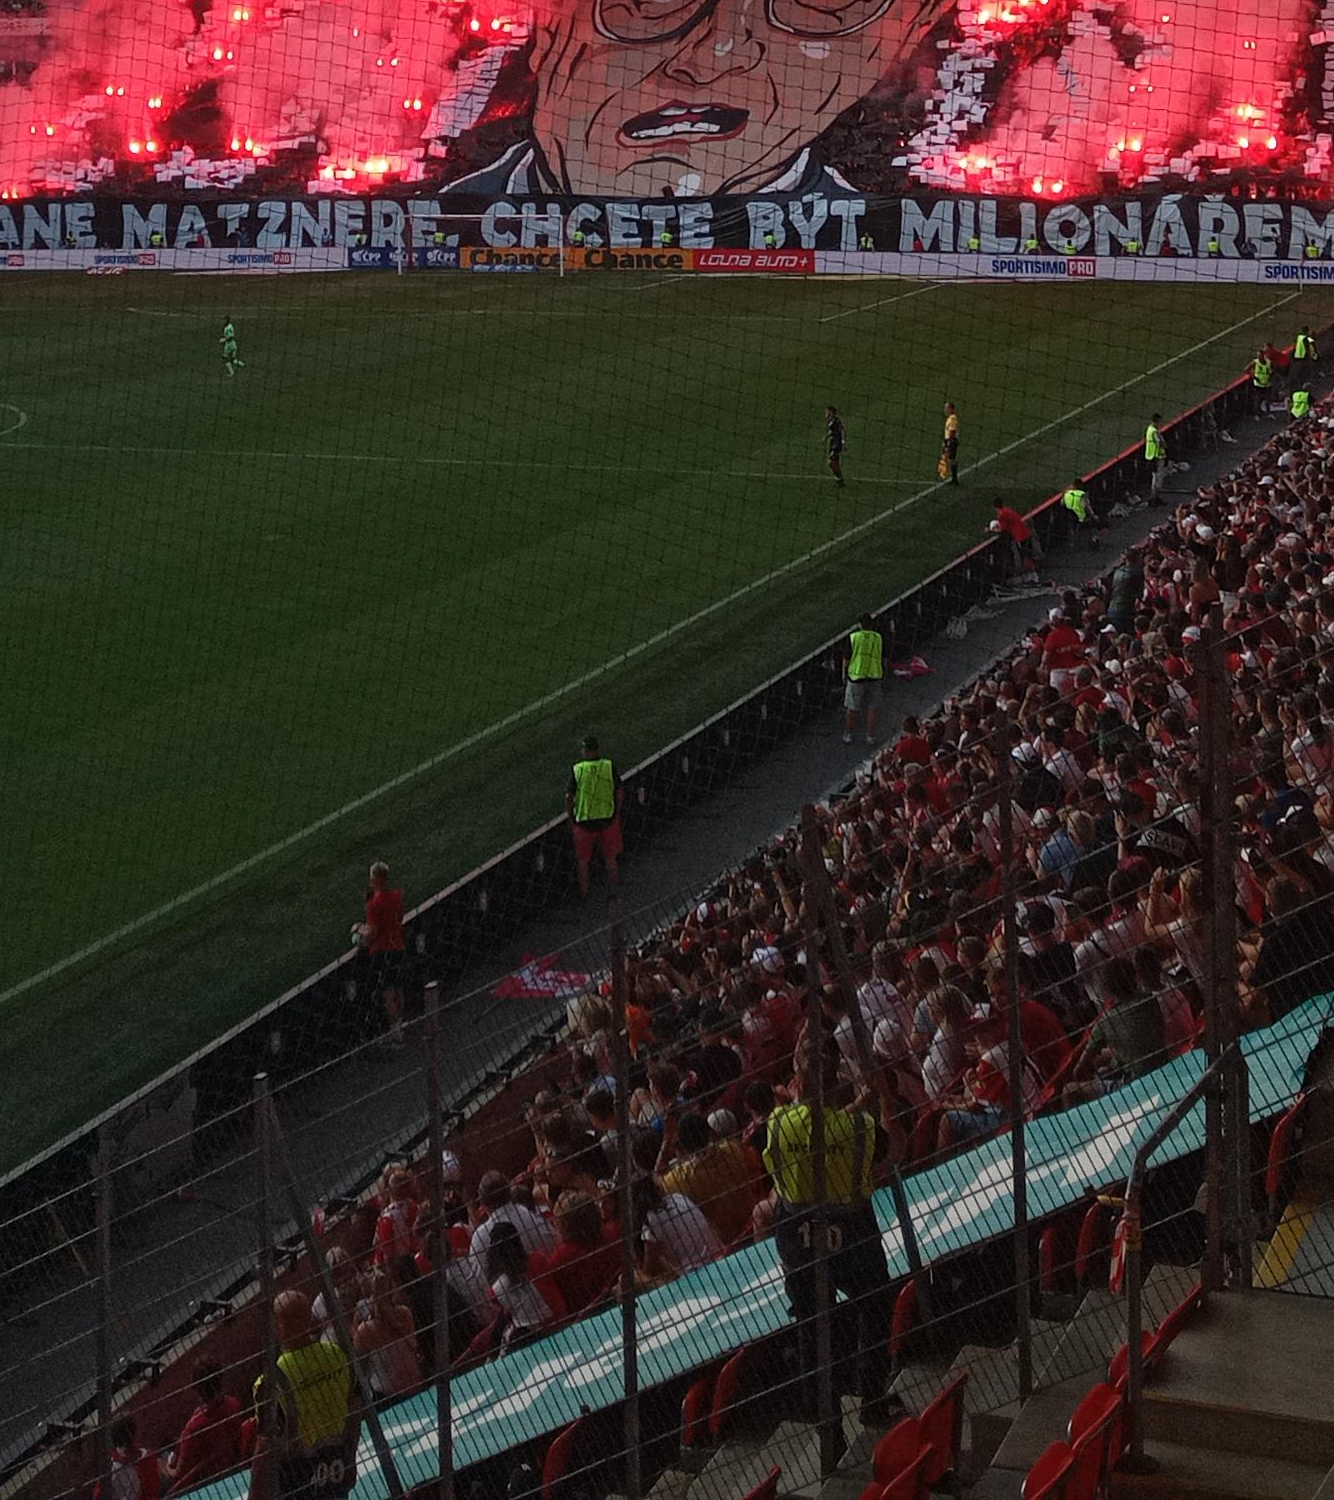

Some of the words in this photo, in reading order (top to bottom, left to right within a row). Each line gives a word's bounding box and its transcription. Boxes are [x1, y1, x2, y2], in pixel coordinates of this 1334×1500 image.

[480, 201, 715, 250] CHCETE
[747, 192, 866, 251] BÝT
[470, 248, 565, 267] Chance
[585, 250, 683, 270] Chance
[991, 259, 1066, 275] SPORTISIMO
[1069, 261, 1094, 275] PRO
